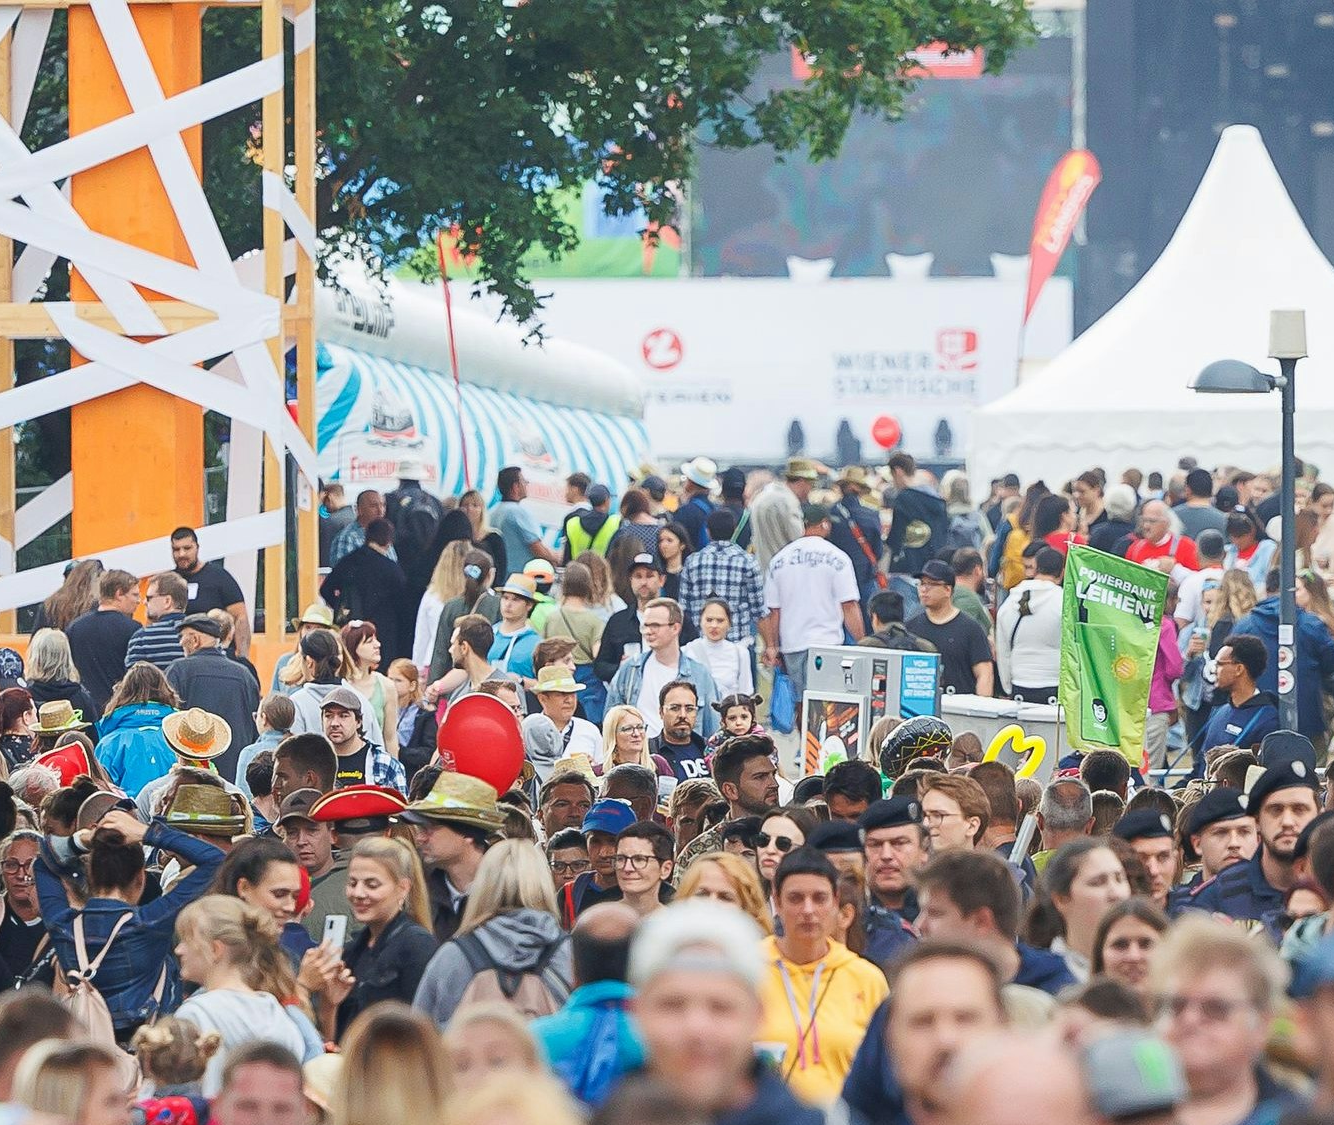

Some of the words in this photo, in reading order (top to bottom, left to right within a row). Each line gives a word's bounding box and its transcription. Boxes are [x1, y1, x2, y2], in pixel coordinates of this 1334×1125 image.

[834, 351, 931, 370] WIENER
[1075, 581, 1156, 620] LEIHEN!
[1079, 566, 1157, 601] POWERBANK
